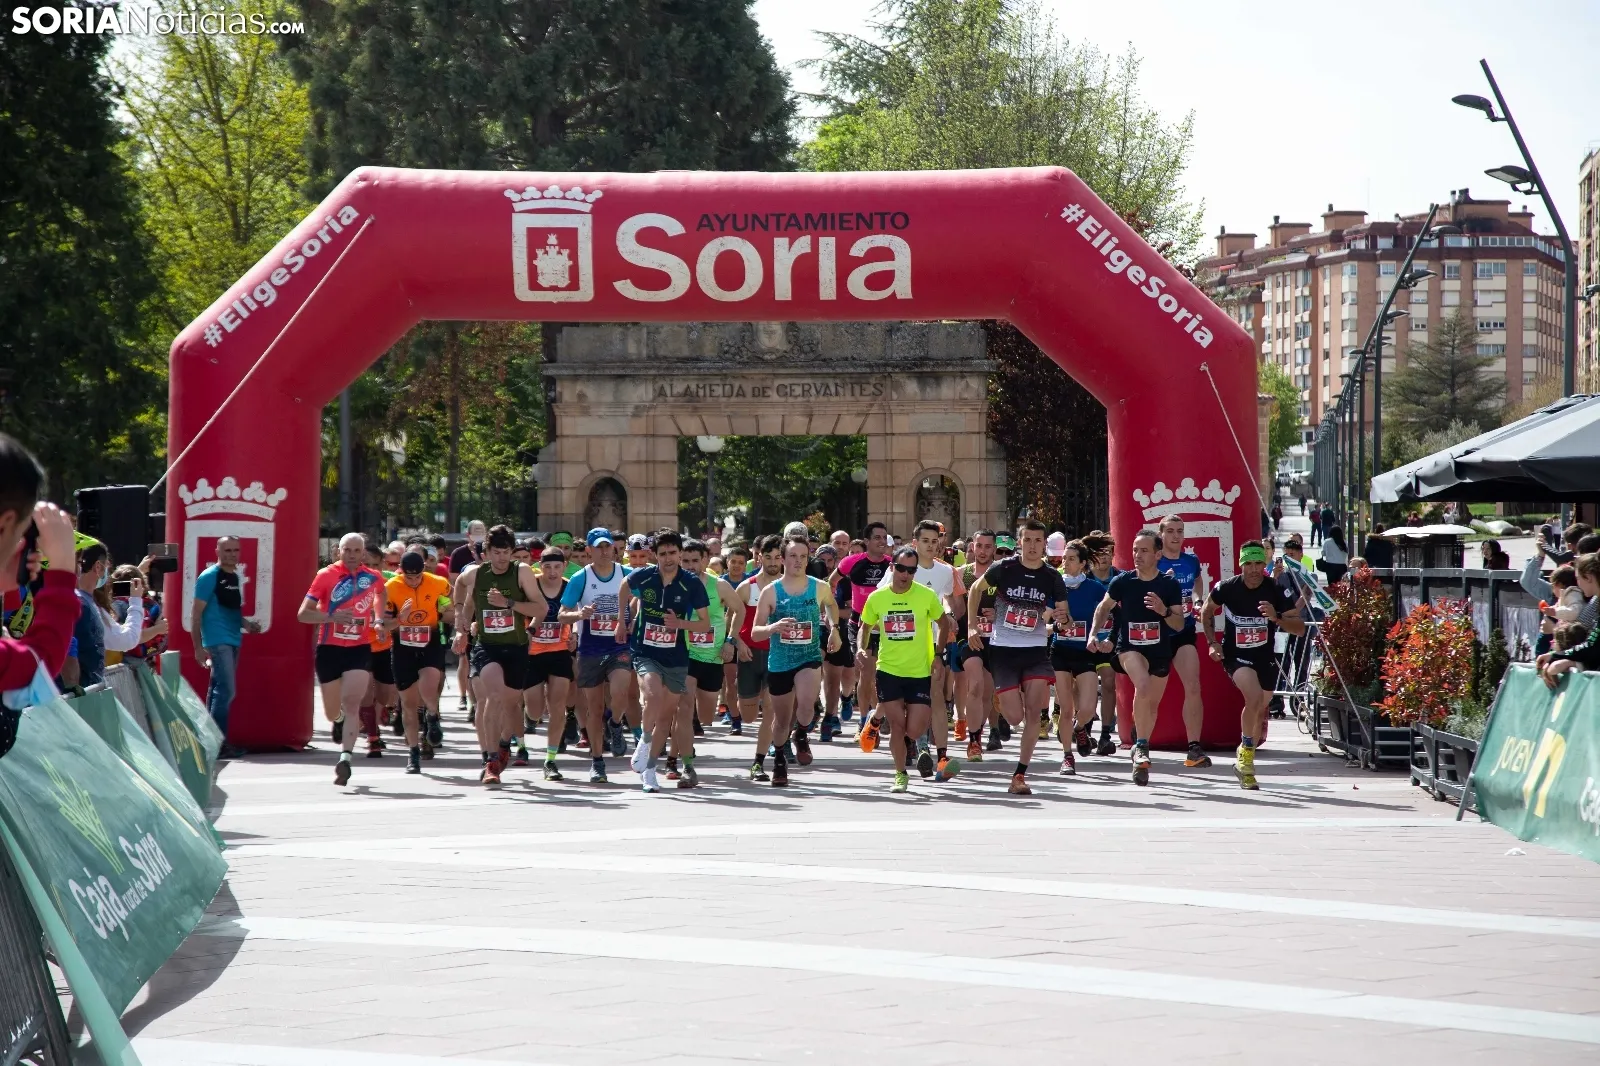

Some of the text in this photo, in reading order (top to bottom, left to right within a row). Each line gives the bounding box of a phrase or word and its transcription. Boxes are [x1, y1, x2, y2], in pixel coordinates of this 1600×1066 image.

[695, 212, 910, 233] AYUNTAMIENTO
[612, 212, 913, 302] Soria
[203, 205, 360, 348] #EligeSoria
[1060, 203, 1214, 349] #EligeSoria
[657, 383, 746, 398] ALAMEDA
[776, 382, 884, 398] CERVANTES
[491, 618, 506, 627] 43
[1014, 616, 1028, 625] 13
[343, 624, 358, 633] 74
[598, 621, 612, 630] 72
[892, 622, 907, 632] 45
[407, 633, 420, 641] 11
[540, 629, 554, 638] 20
[650, 630, 672, 642] 120
[692, 632, 707, 642] 73
[789, 630, 804, 639] 92
[1065, 628, 1077, 637] 21
[1140, 631, 1147, 639] 1
[1244, 634, 1260, 643] 25
[1490, 735, 1536, 777] JOVEN
[68, 866, 129, 942] Caja
[118, 823, 173, 892] Soria
